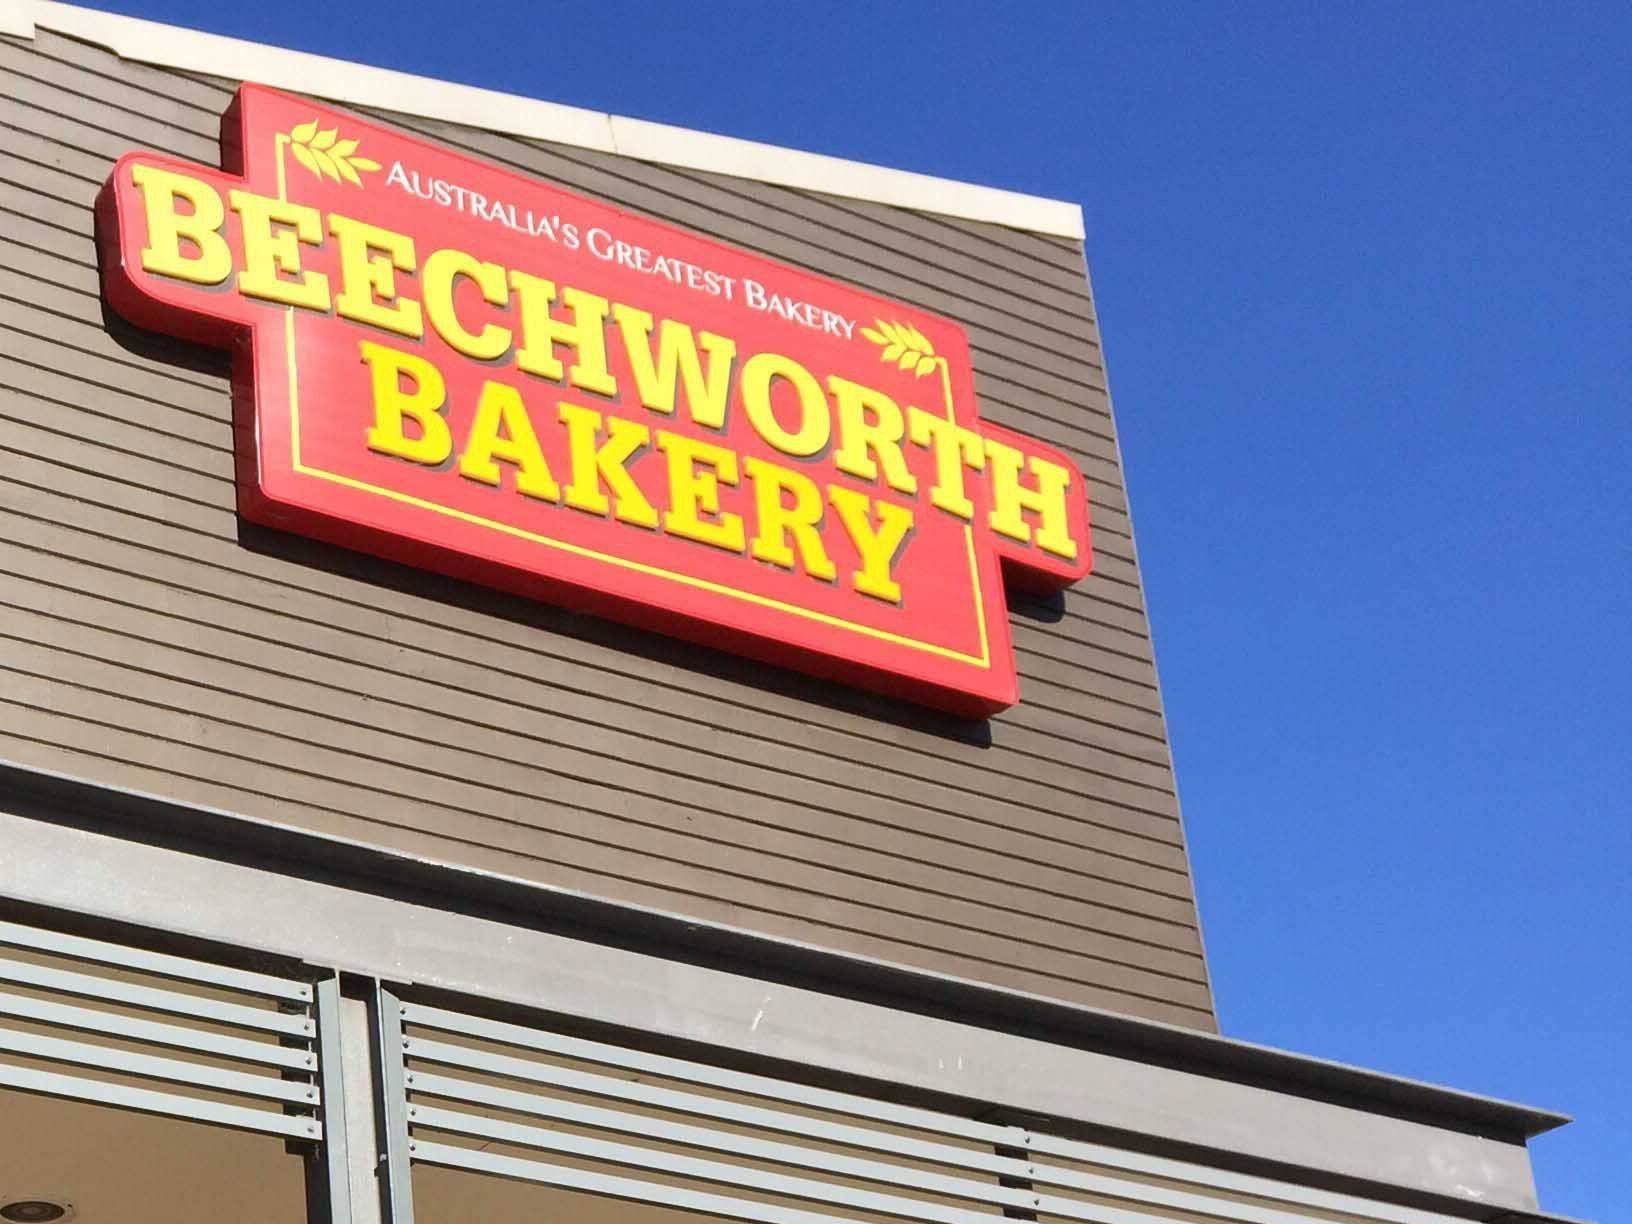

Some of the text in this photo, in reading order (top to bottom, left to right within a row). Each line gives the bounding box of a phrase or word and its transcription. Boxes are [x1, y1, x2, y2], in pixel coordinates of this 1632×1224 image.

[131, 164, 1077, 559] BEECHWORTH
[386, 160, 857, 341] AUSTRALIA'S GREATEST BAKERY
[360, 341, 914, 602] BAKERY
